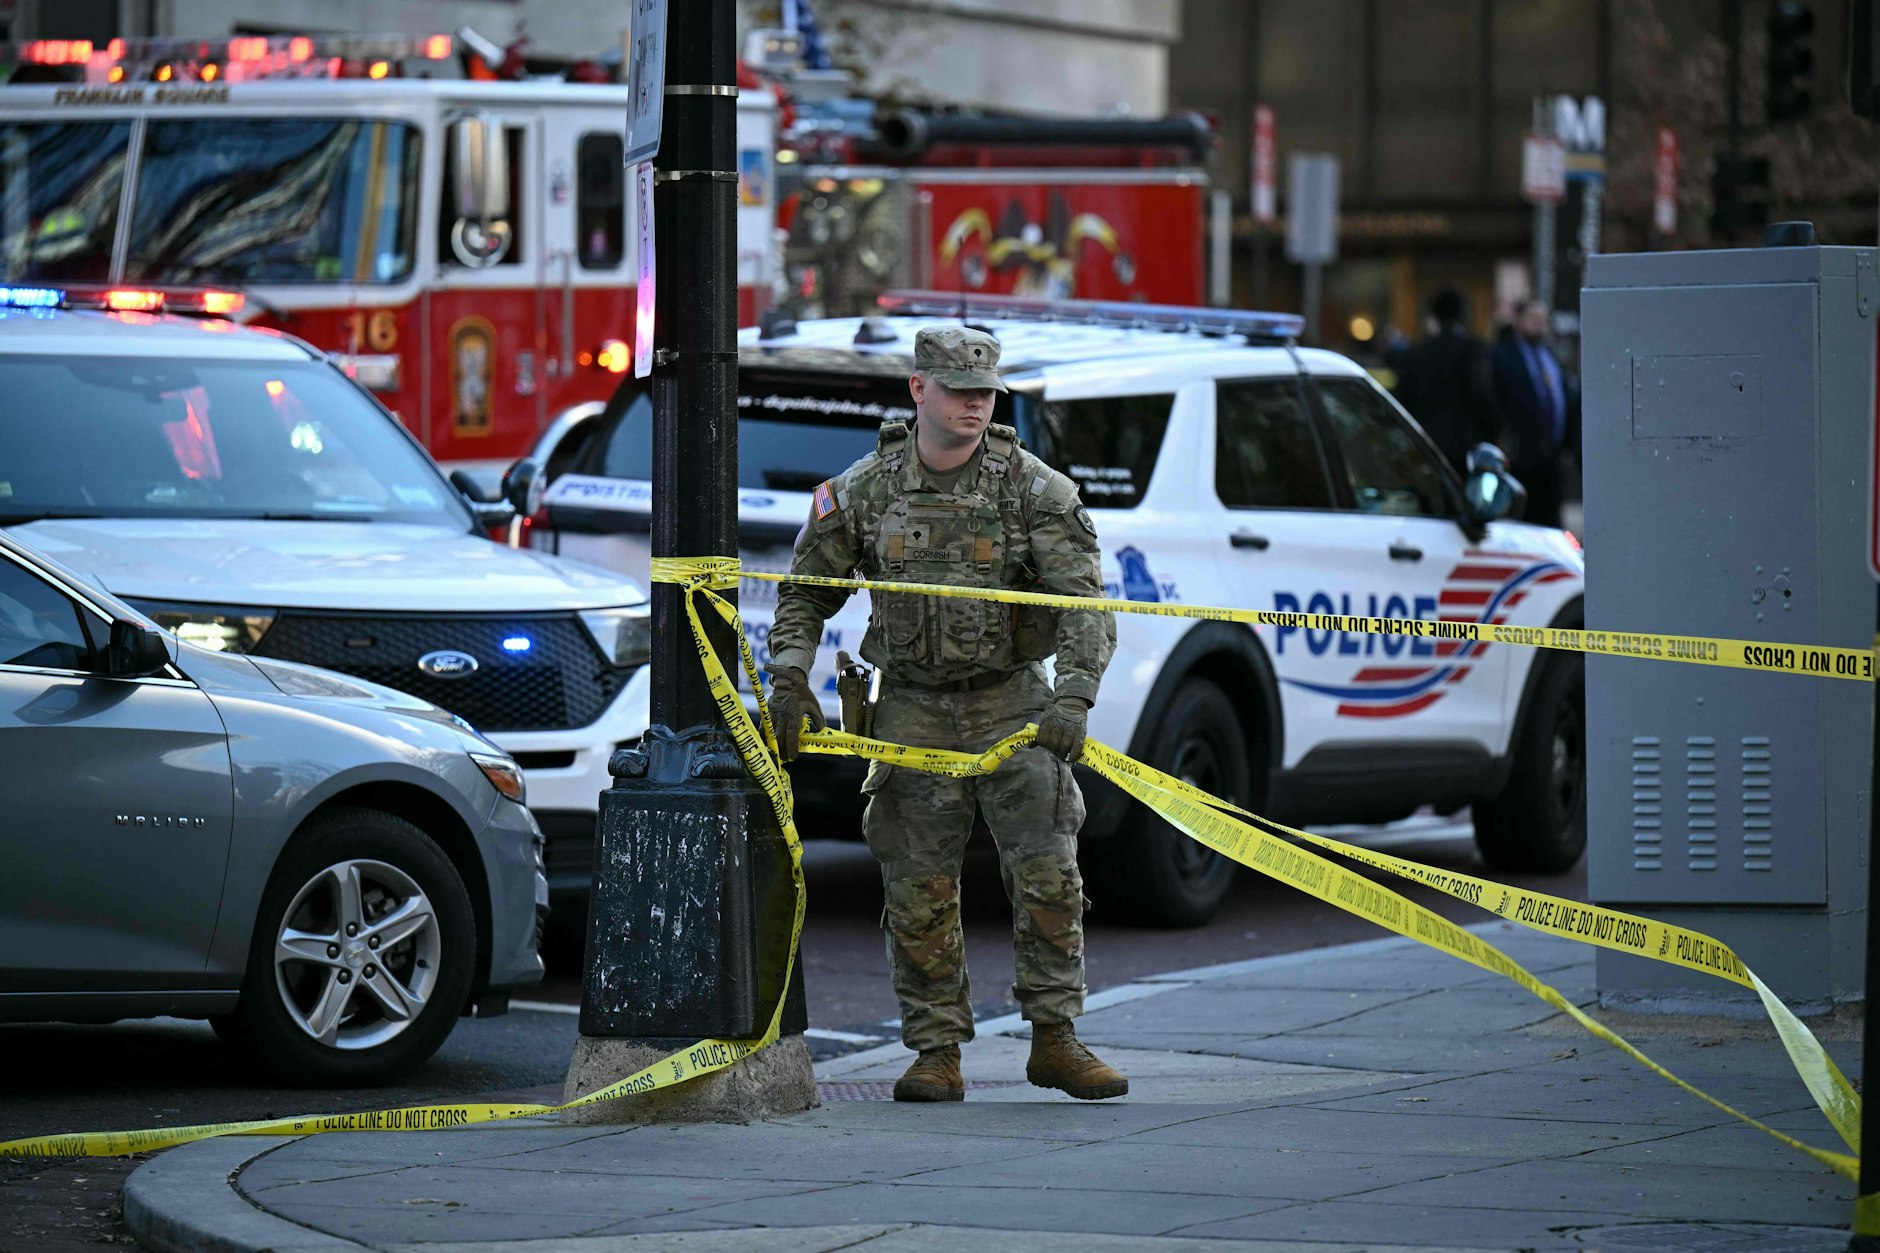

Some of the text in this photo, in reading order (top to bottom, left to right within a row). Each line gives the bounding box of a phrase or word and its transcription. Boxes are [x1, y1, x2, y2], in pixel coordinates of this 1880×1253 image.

[348, 310, 398, 351] 16
[913, 550, 950, 560] CORNISH
[1258, 612, 1308, 629] CROSS
[1273, 591, 1437, 658] POLICE
[1316, 614, 1343, 631] NOT
[1374, 618, 1423, 636] SCENE
[1429, 622, 1479, 641] CRIME
[1493, 626, 1719, 661] CRIME SCENE DO NOT CROSS
[1744, 645, 1795, 669] CROSS
[1801, 651, 1830, 673] NOT
[1836, 653, 1858, 676] DO
[716, 694, 746, 730] POLICE
[733, 729, 759, 756] LINE
[746, 752, 767, 773] DO
[756, 769, 779, 793] NOT
[769, 790, 793, 828] CROSS
[115, 815, 205, 828] MALIBU
[1449, 877, 1483, 905] CROSS
[1515, 896, 1647, 949] POLICE LINE DO NOT CROSS
[1675, 934, 1704, 965] POLICE
[1704, 942, 1722, 970] LINE
[1720, 948, 1733, 973] DO
[689, 1044, 730, 1070] POLICE
[619, 1073, 655, 1097] CROSS
[358, 1111, 383, 1129] LINE
[386, 1110, 401, 1129] DO
[405, 1109, 427, 1129] NOT
[430, 1109, 467, 1127] CROSS
